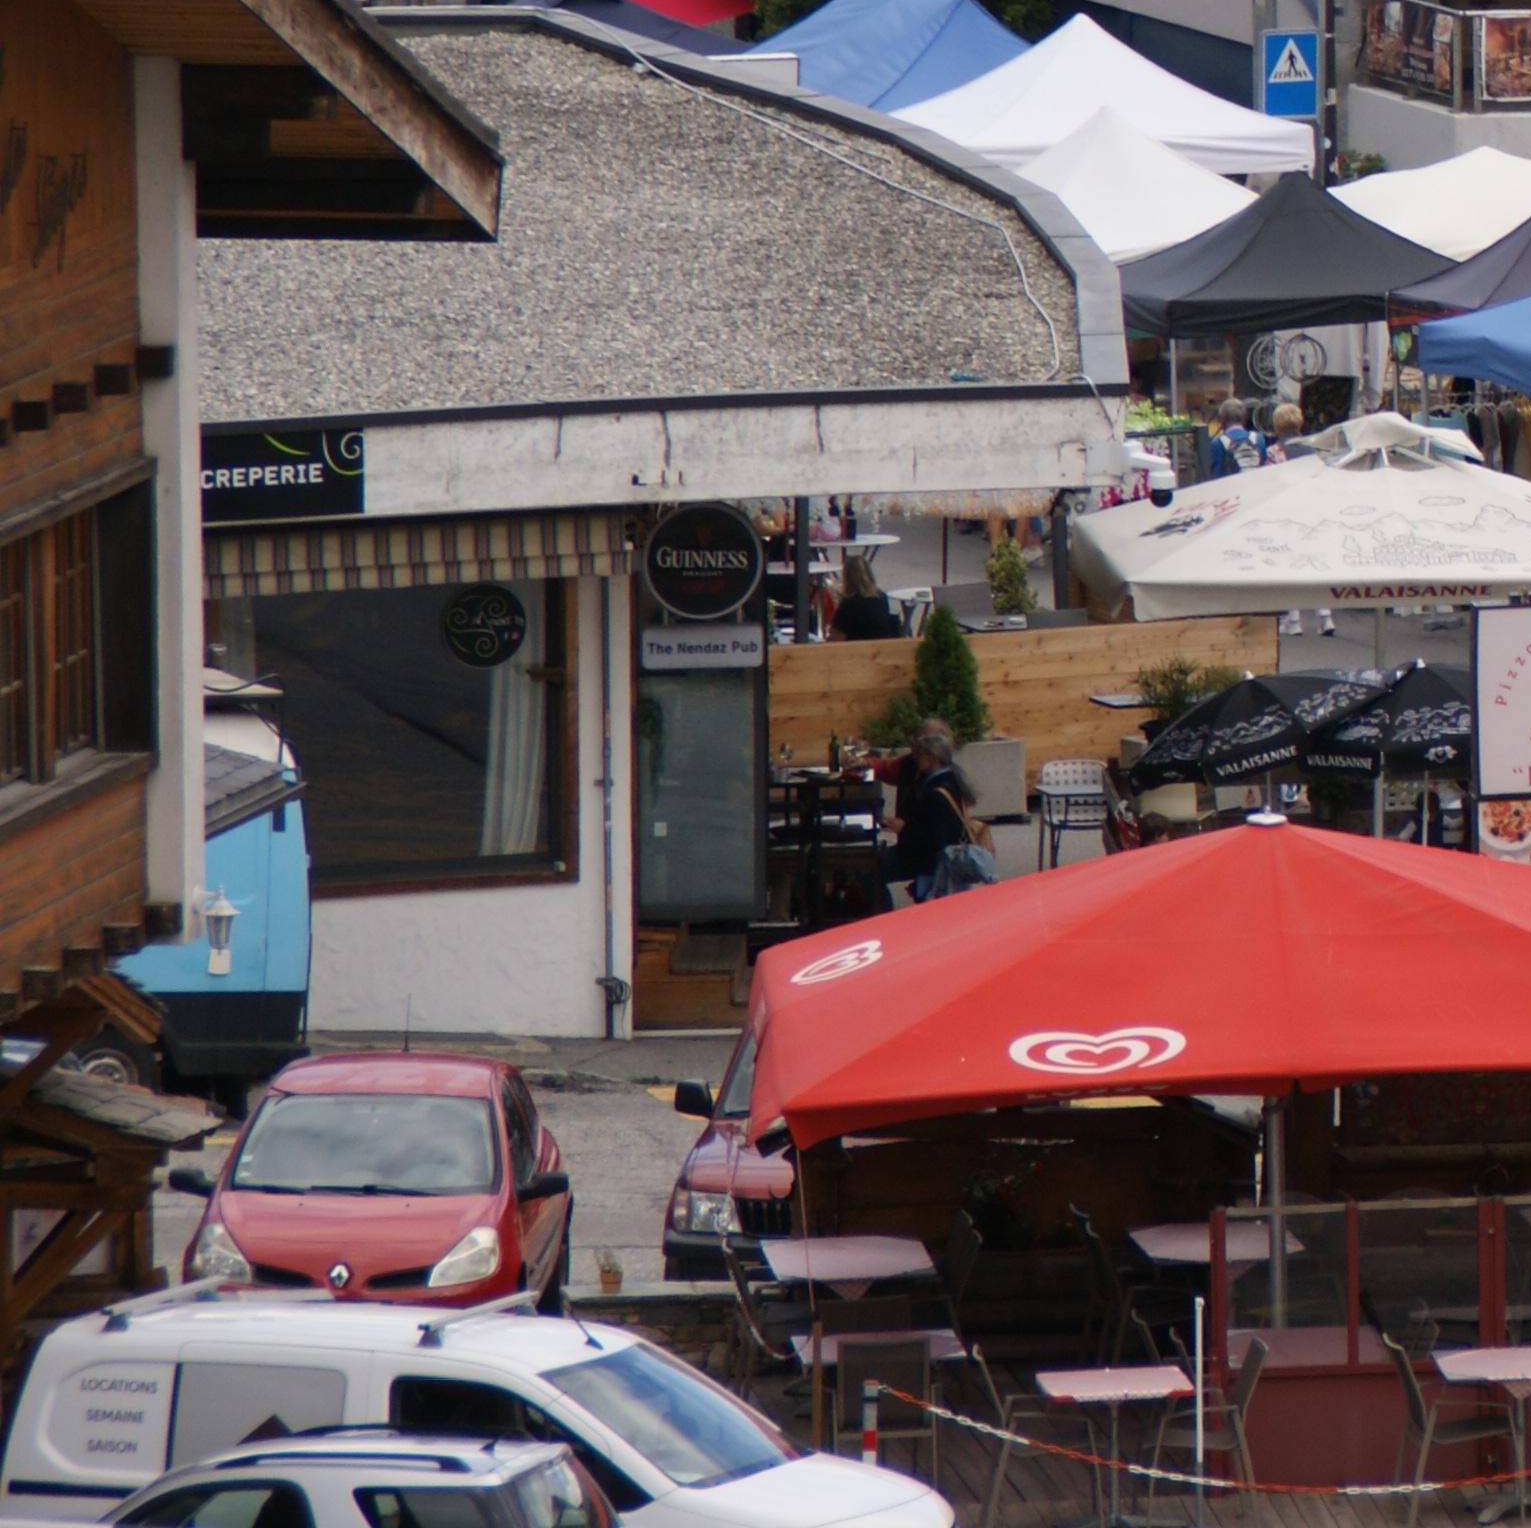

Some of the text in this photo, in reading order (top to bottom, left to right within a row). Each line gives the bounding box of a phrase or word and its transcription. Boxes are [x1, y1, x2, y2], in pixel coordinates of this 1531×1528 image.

[202, 463, 324, 489] CREPERIE
[656, 545, 749, 570] GUINNESS
[1330, 583, 1492, 601] VALAISANNE
[649, 640, 758, 655] The Nendaz Pub
[1216, 744, 1298, 778] VALAISANNE
[1306, 753, 1374, 771] VALAISANNE
[80, 1377, 158, 1394] LOCATIONS
[86, 1408, 143, 1424] SEMAINE
[87, 1439, 138, 1454] SAISON
